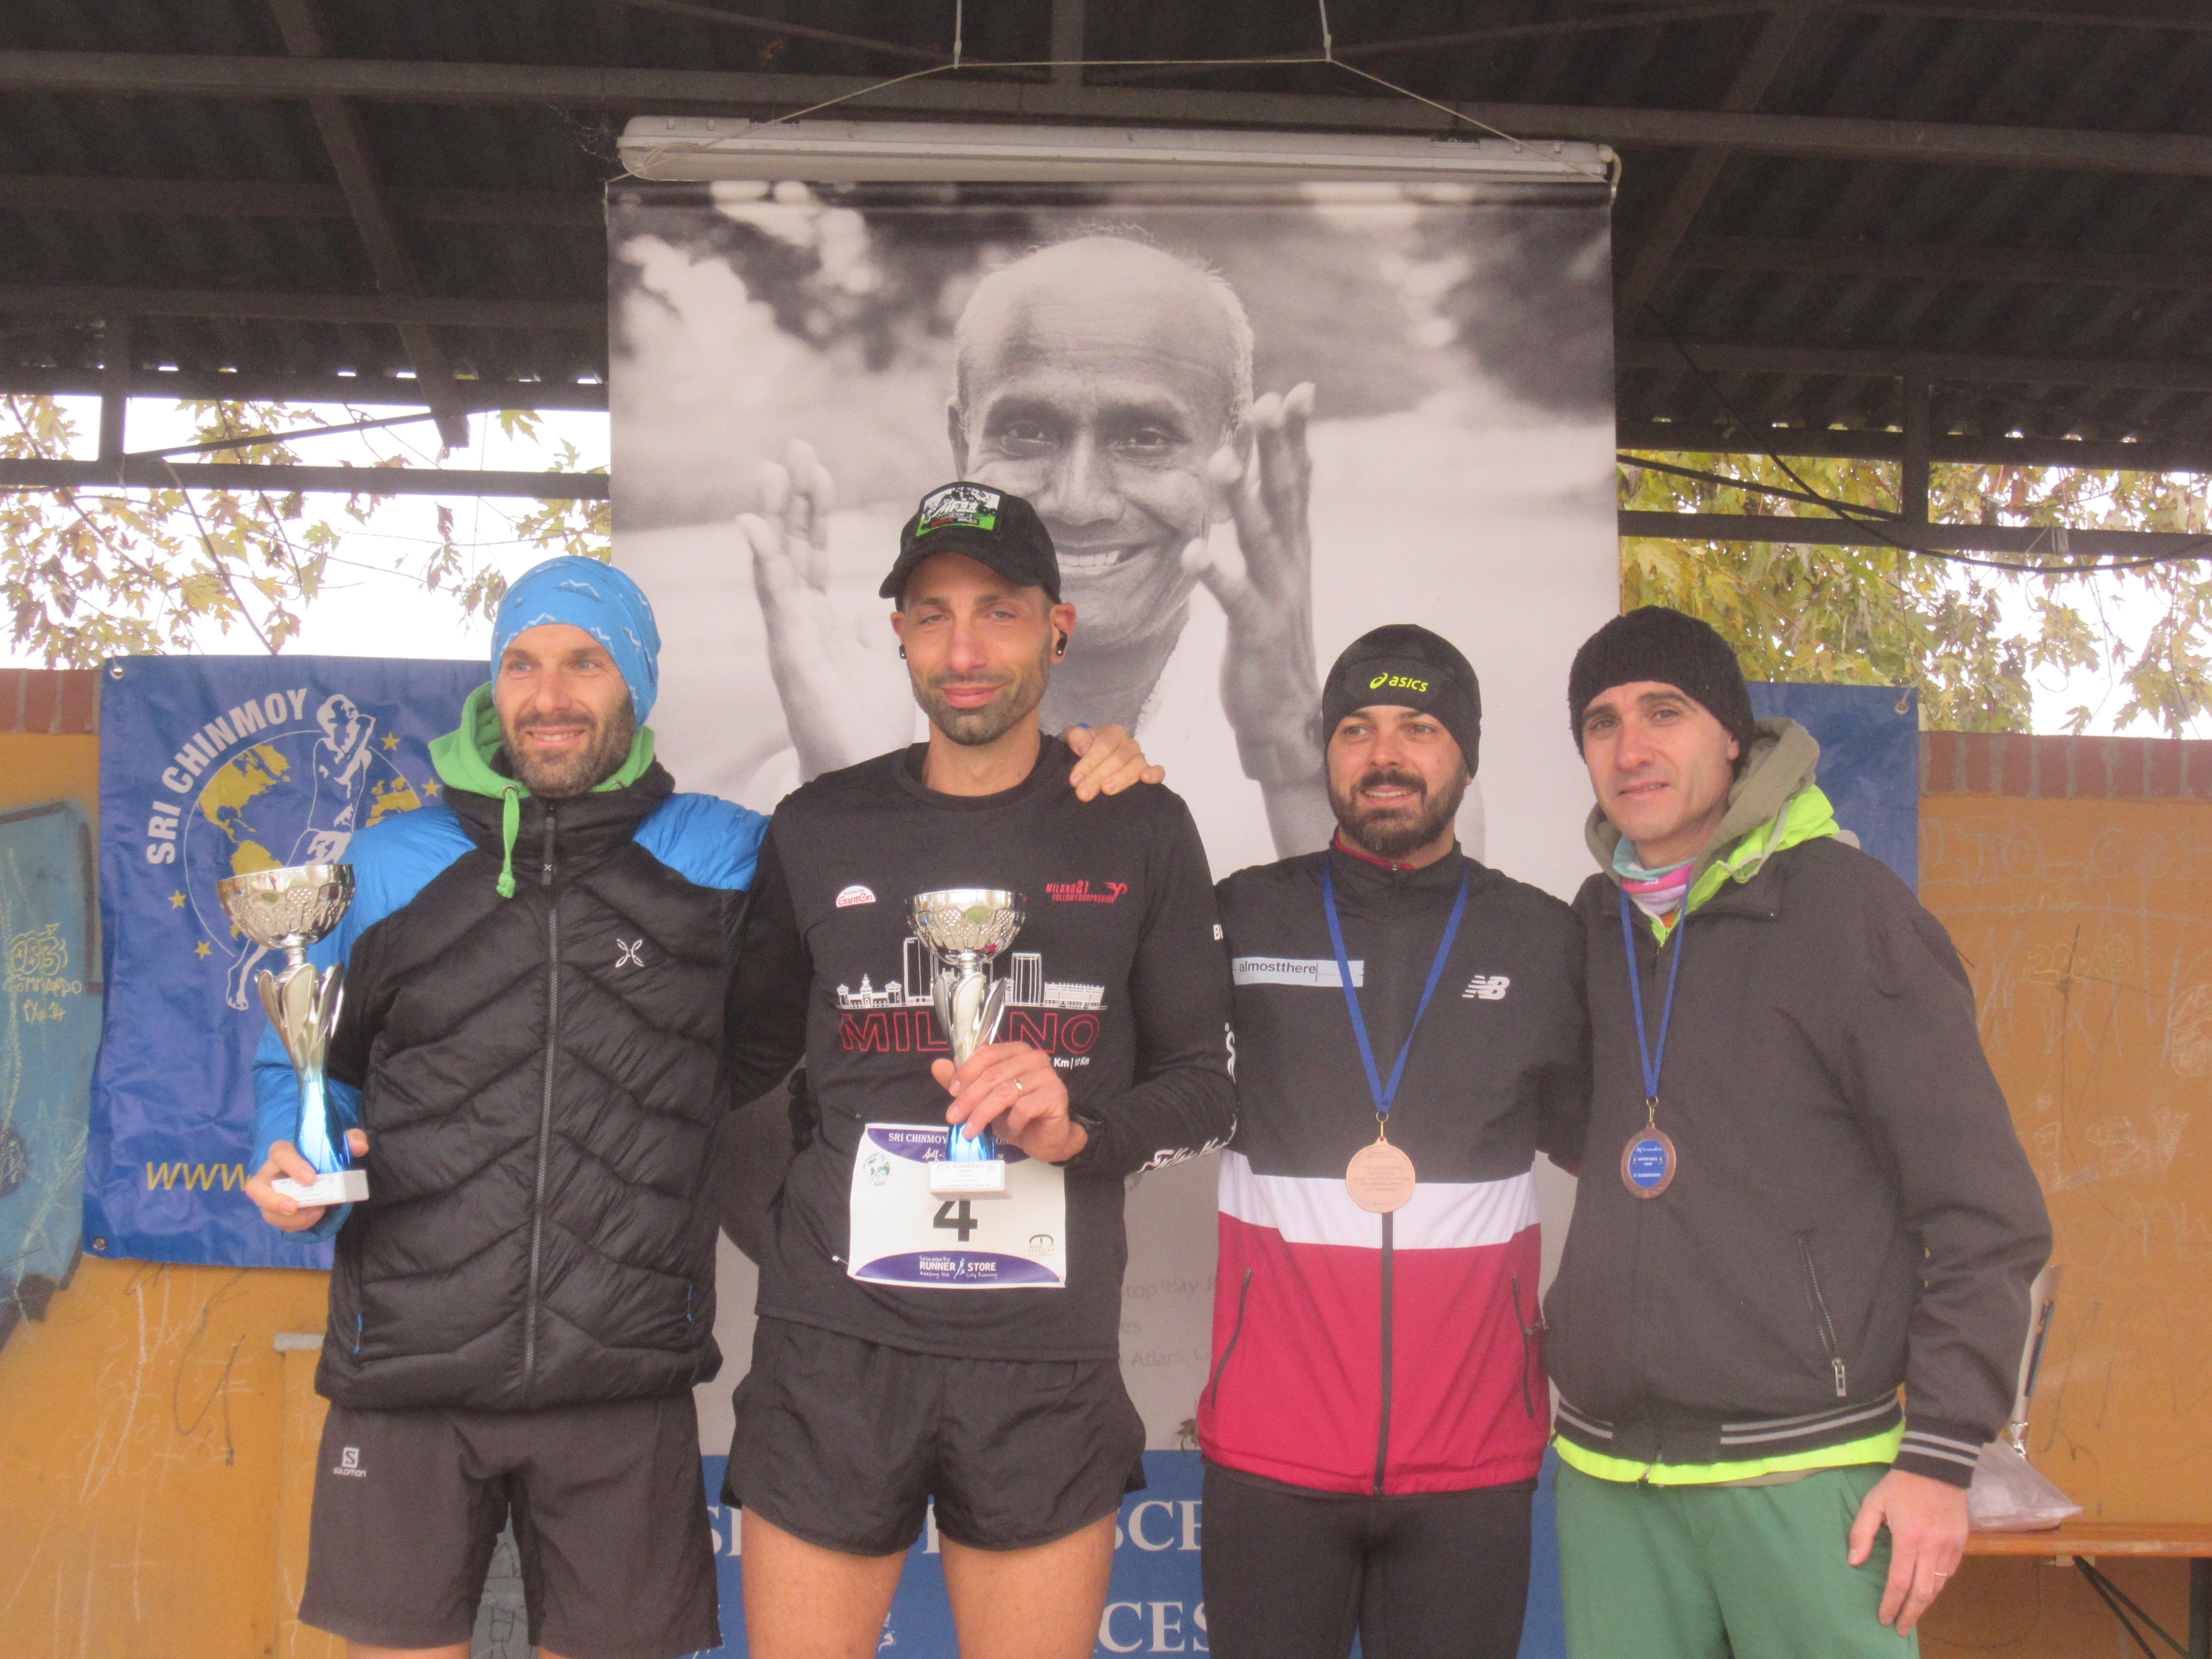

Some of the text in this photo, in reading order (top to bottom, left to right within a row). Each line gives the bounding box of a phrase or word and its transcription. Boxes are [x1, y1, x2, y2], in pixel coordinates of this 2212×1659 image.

[1388, 675, 1429, 692] asics
[146, 688, 307, 864] SRI CHINMOY
[1238, 962, 1317, 974] almostthere
[840, 1011, 1100, 1054] MILNO
[1054, 1058, 1070, 1068] Km
[889, 1133, 948, 1144] SRI CHINMOY
[933, 1200, 978, 1242] 4
[919, 1262, 996, 1272] RUNNER STORE
